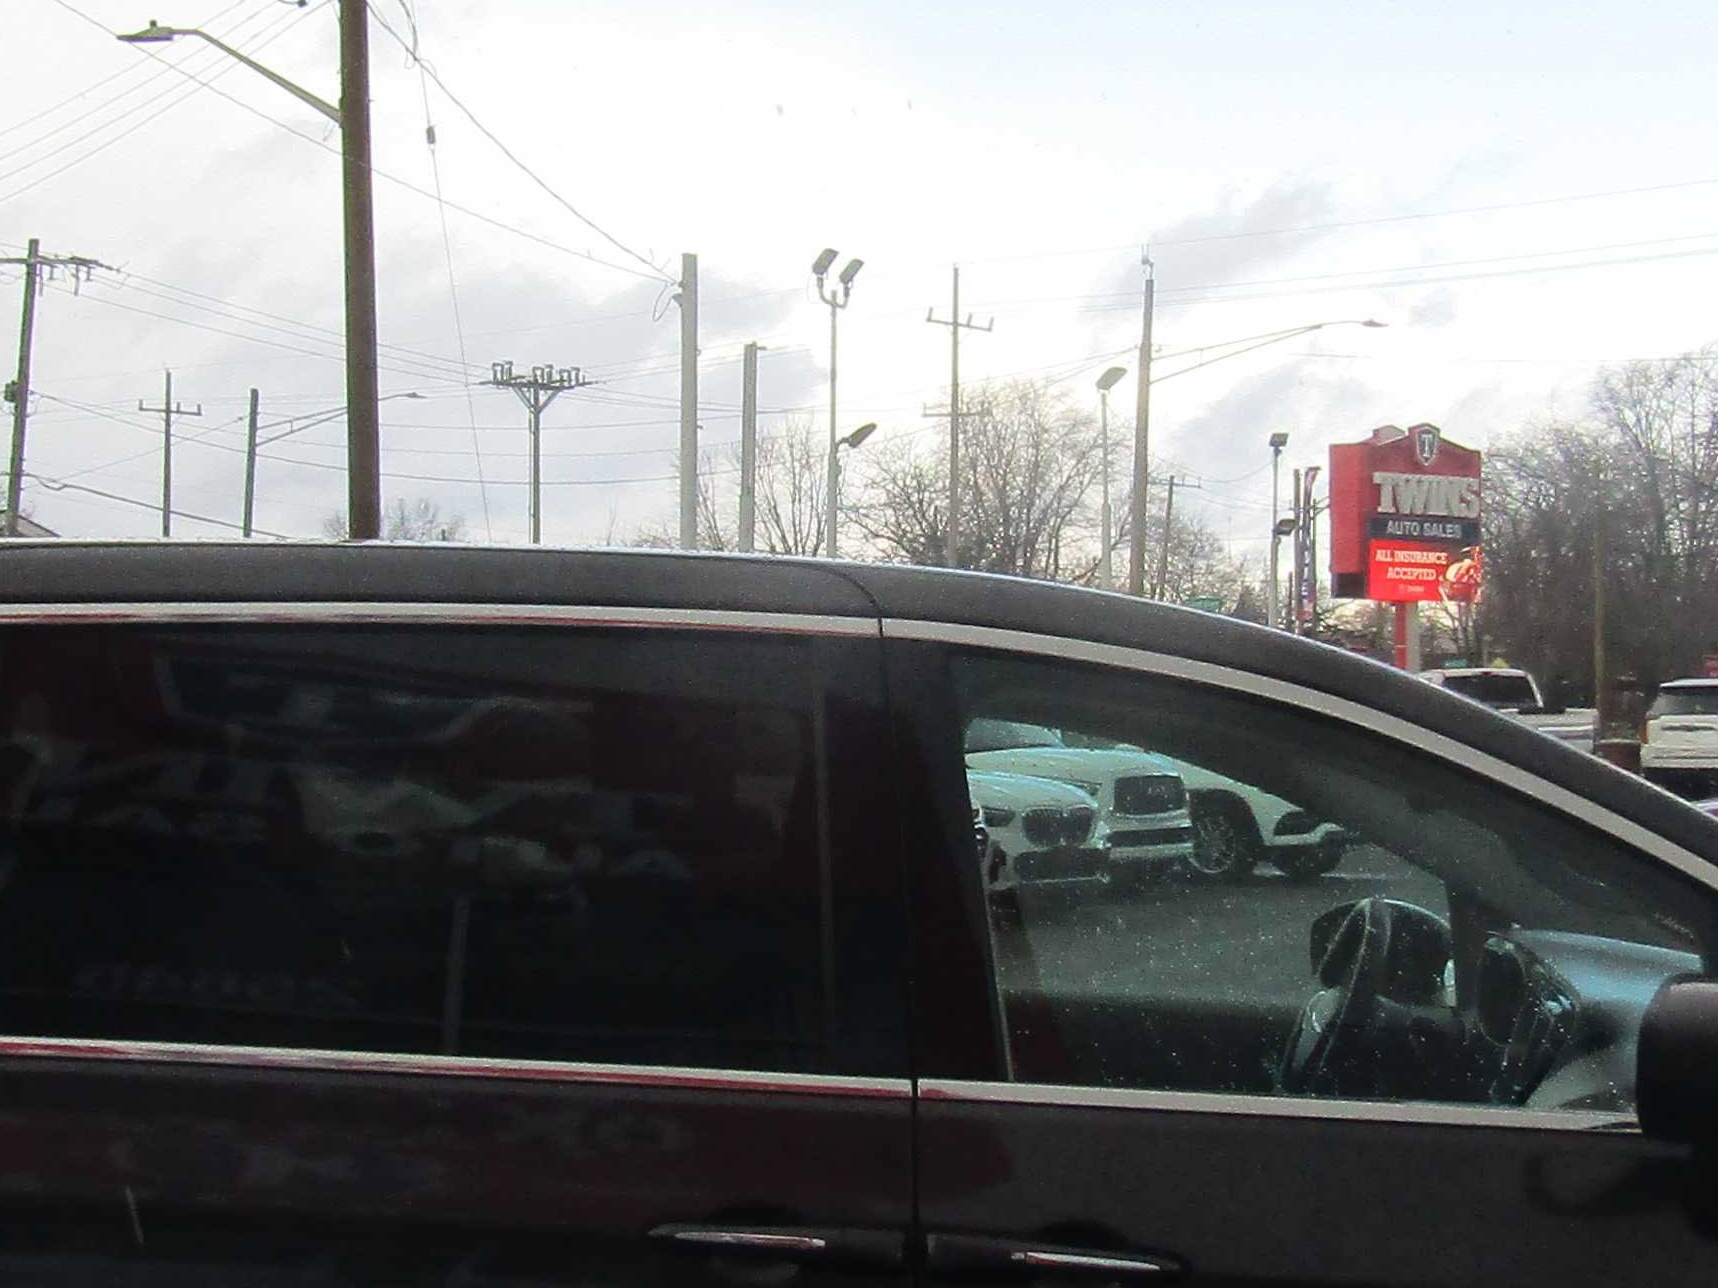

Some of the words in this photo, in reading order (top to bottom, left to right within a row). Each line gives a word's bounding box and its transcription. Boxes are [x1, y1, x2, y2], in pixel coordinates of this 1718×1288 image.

[1372, 472, 1478, 519] TWINS
[1386, 520, 1419, 535] AUTO
[1422, 523, 1461, 538] SALES
[1375, 549, 1393, 562] ALL
[1394, 551, 1448, 564] INSURANCE
[1387, 567, 1436, 581] ACCEPTED
